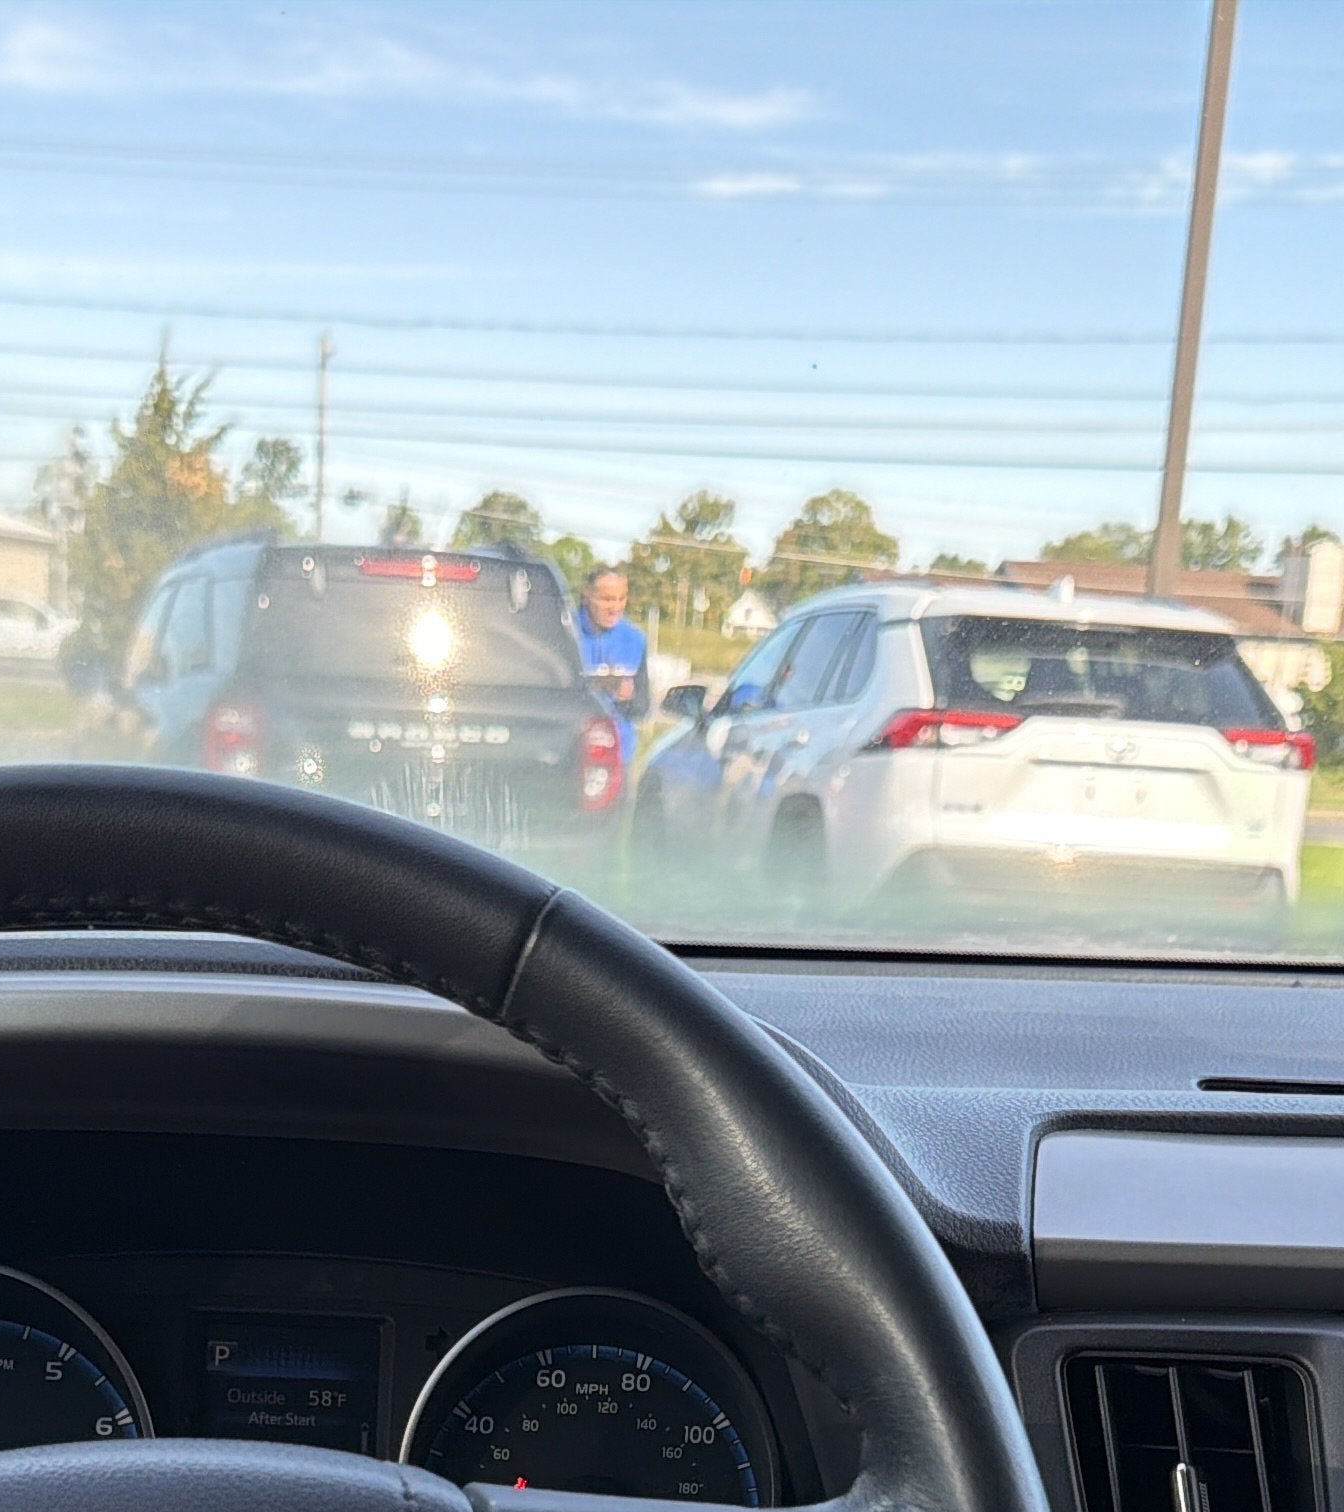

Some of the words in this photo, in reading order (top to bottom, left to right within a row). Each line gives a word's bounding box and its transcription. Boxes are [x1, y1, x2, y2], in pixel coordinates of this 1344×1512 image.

[215, 1345, 230, 1366] P
[45, 1361, 63, 1381] 5
[536, 1369, 567, 1388] 60
[575, 1383, 609, 1396] MPH
[621, 1373, 651, 1392] 80
[227, 1388, 286, 1405] Outside
[556, 1402, 578, 1415] 100
[597, 1402, 619, 1414] 120
[95, 1416, 113, 1435] 6
[248, 1411, 282, 1426] After
[285, 1412, 316, 1427] Start
[465, 1416, 494, 1434] 40
[522, 1419, 540, 1432] 80
[636, 1418, 657, 1431] 140
[683, 1425, 715, 1445] 100
[492, 1448, 510, 1461] 60
[661, 1446, 683, 1459] 160
[678, 1481, 699, 1495] 180
